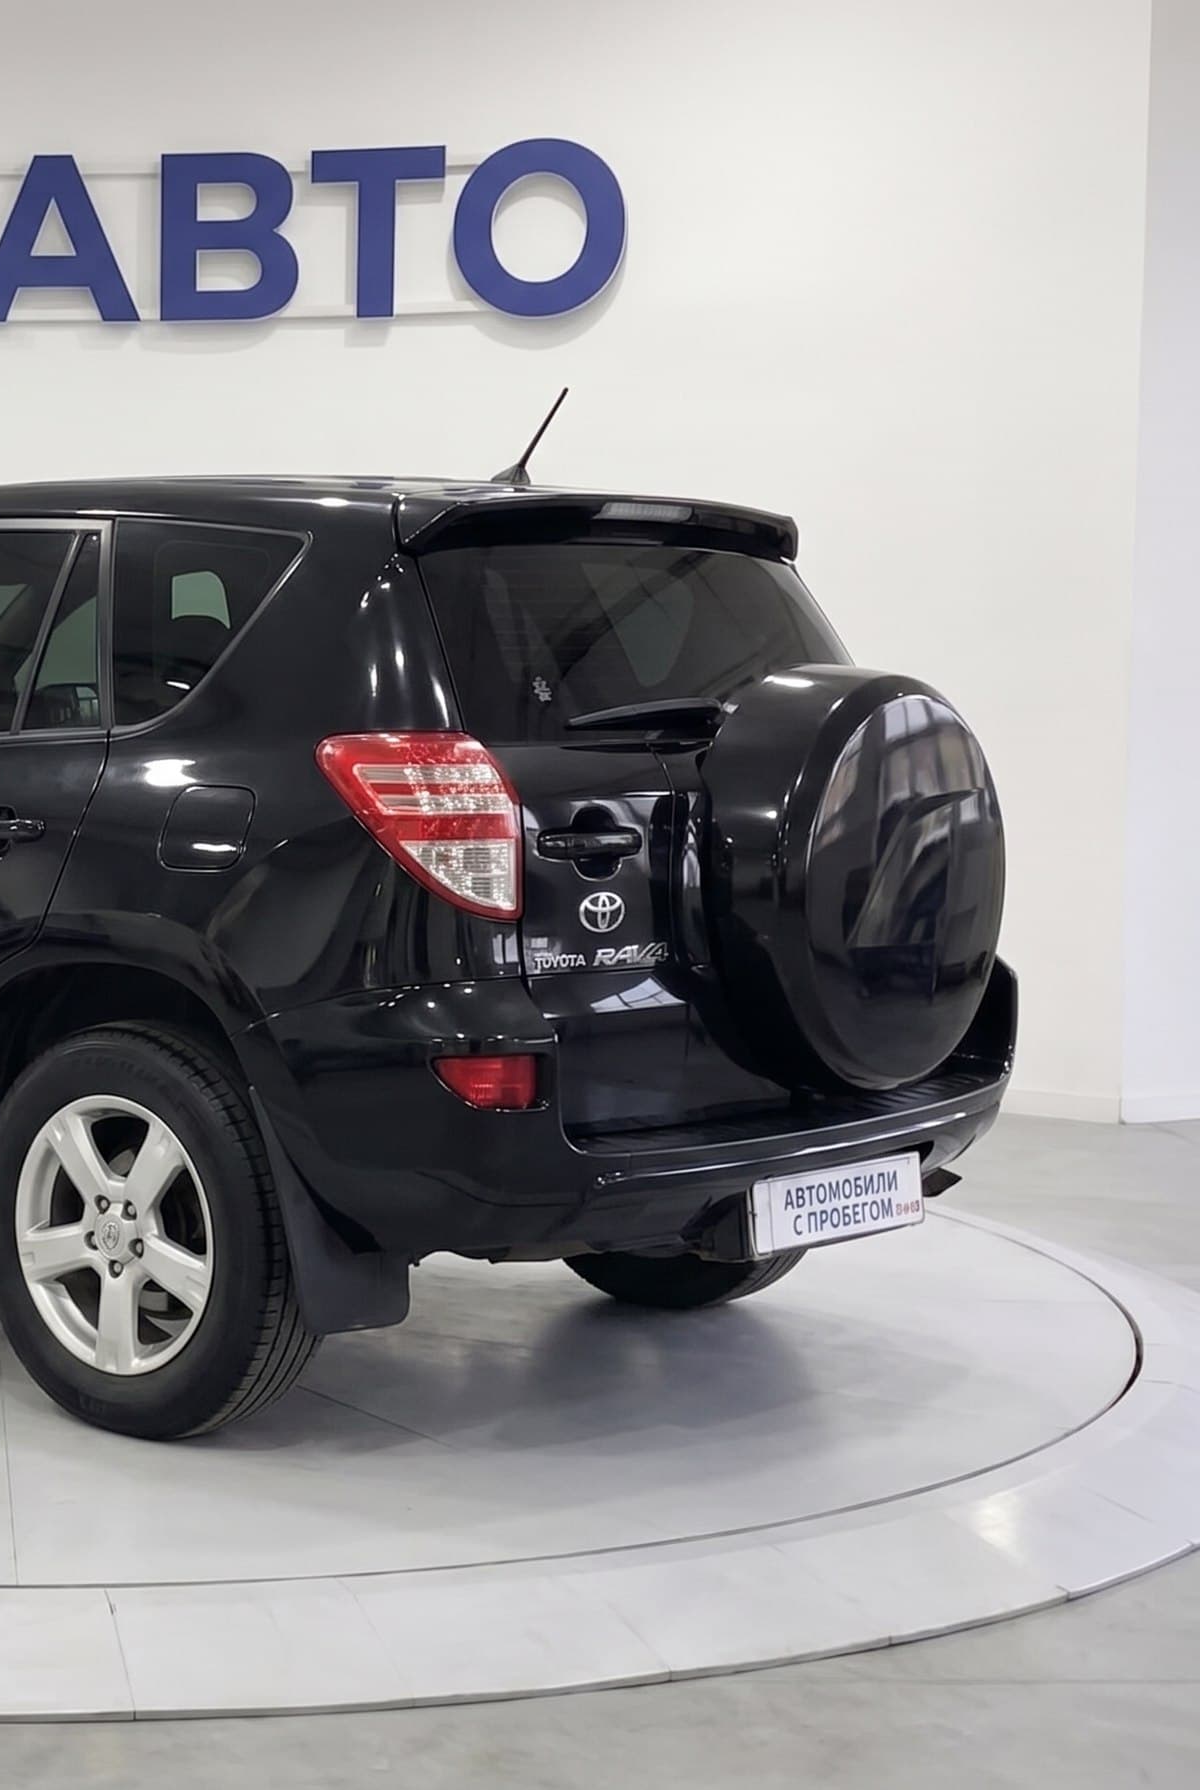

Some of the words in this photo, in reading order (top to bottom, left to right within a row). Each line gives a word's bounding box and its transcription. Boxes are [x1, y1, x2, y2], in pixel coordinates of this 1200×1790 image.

[534, 953, 587, 970] TOYOTA
[592, 942, 669, 967] RAV4
[784, 1169, 899, 1211] АВТОМОБИЛИ
[793, 1212, 804, 1236] С
[807, 1197, 895, 1234] ПРОБЕГОМ
